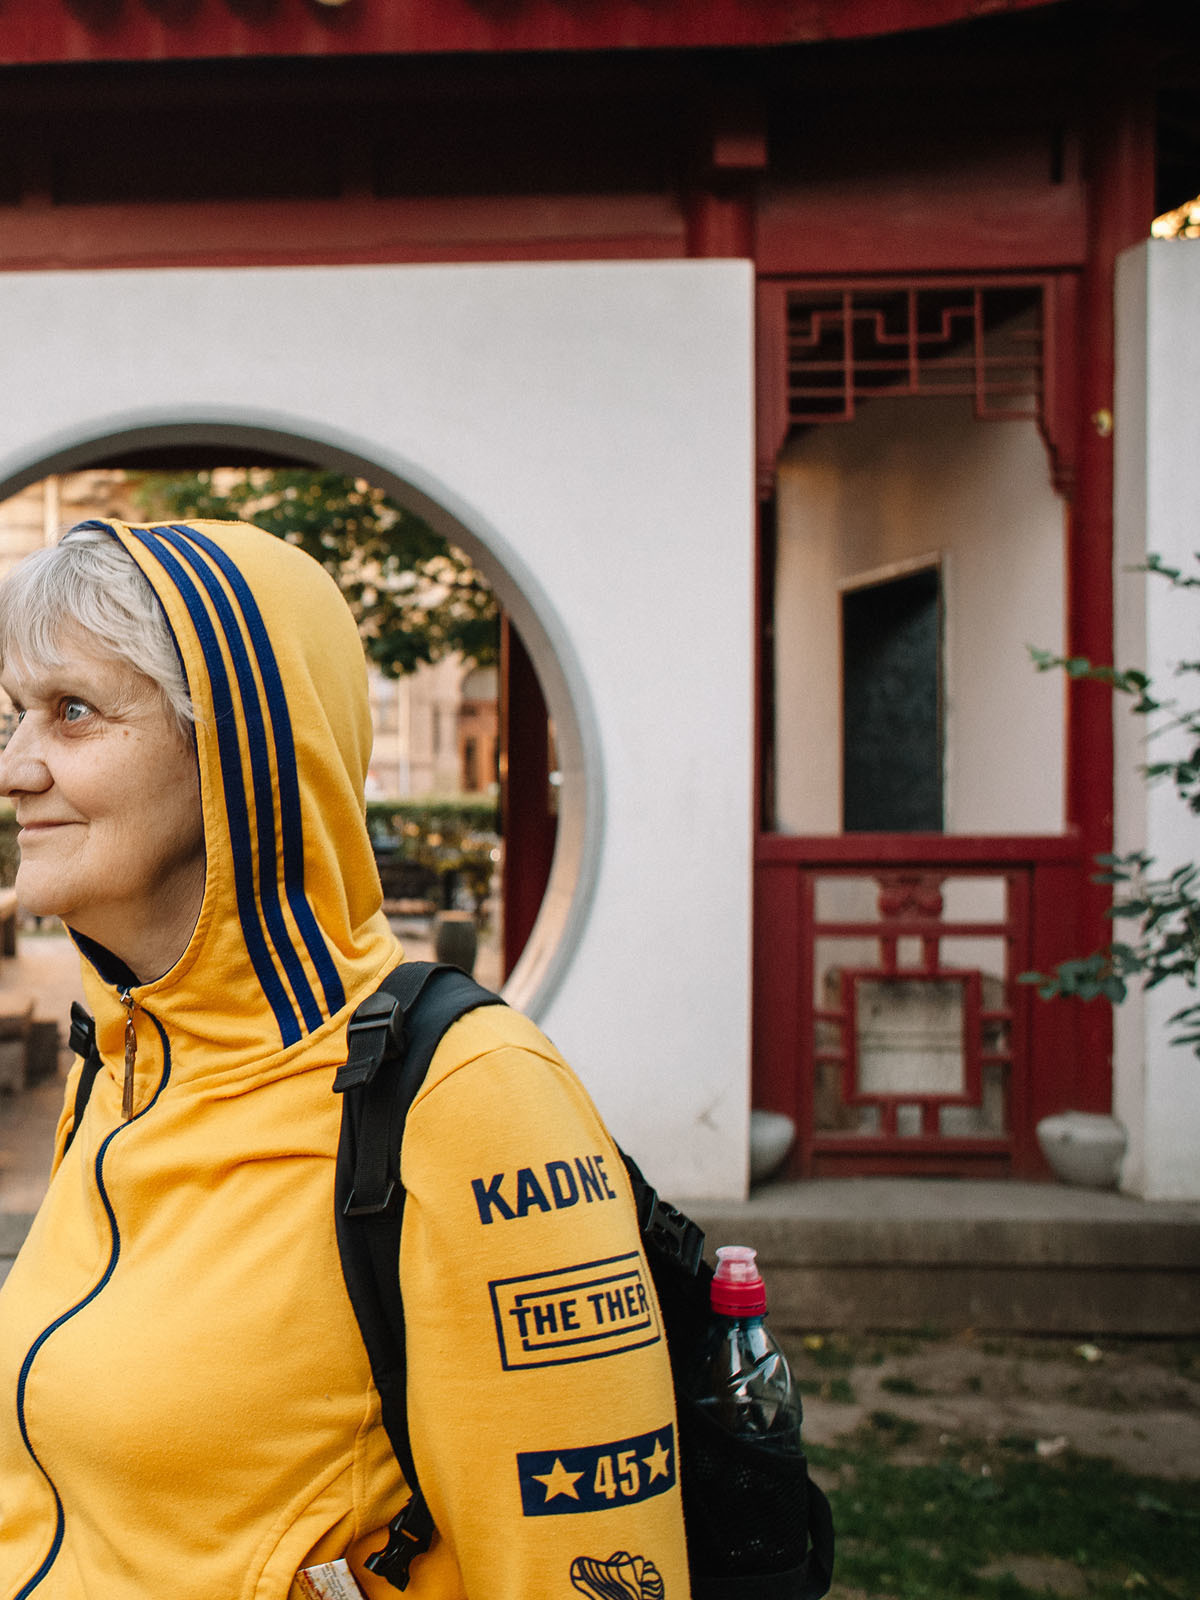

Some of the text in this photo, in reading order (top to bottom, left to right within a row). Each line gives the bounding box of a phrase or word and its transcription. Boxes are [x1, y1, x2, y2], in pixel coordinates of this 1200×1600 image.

[471, 1155, 616, 1225] KADNE
[509, 1283, 649, 1338] THE THER
[593, 1450, 640, 1500] 45
